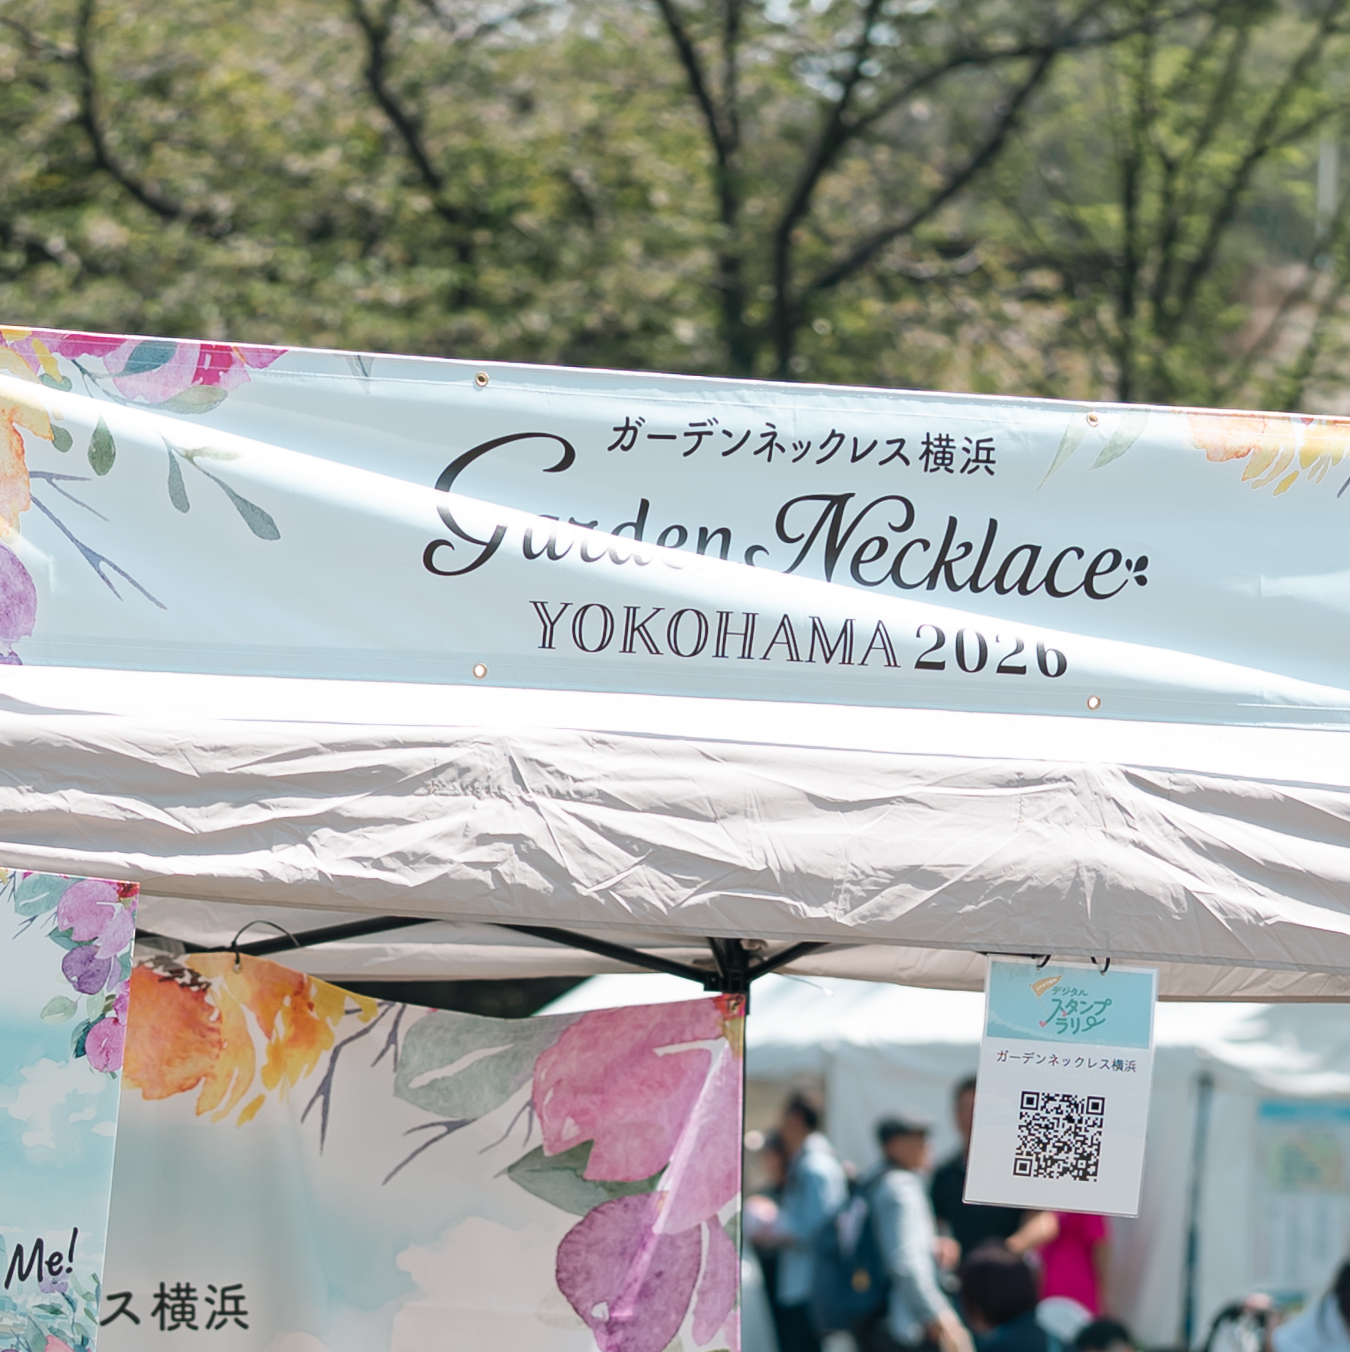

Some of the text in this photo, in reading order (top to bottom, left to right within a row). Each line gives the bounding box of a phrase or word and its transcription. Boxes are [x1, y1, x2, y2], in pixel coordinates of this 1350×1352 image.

[608, 415, 997, 478] ガーデンネックレス横浜
[423, 431, 1127, 600] Garden Necklace
[529, 599, 1069, 679] YOKOHAMA 2026
[1052, 986, 1089, 997] デジタル
[996, 1050, 1138, 1074] ガーデンネックレス横浜
[3, 1227, 80, 1290] Me!
